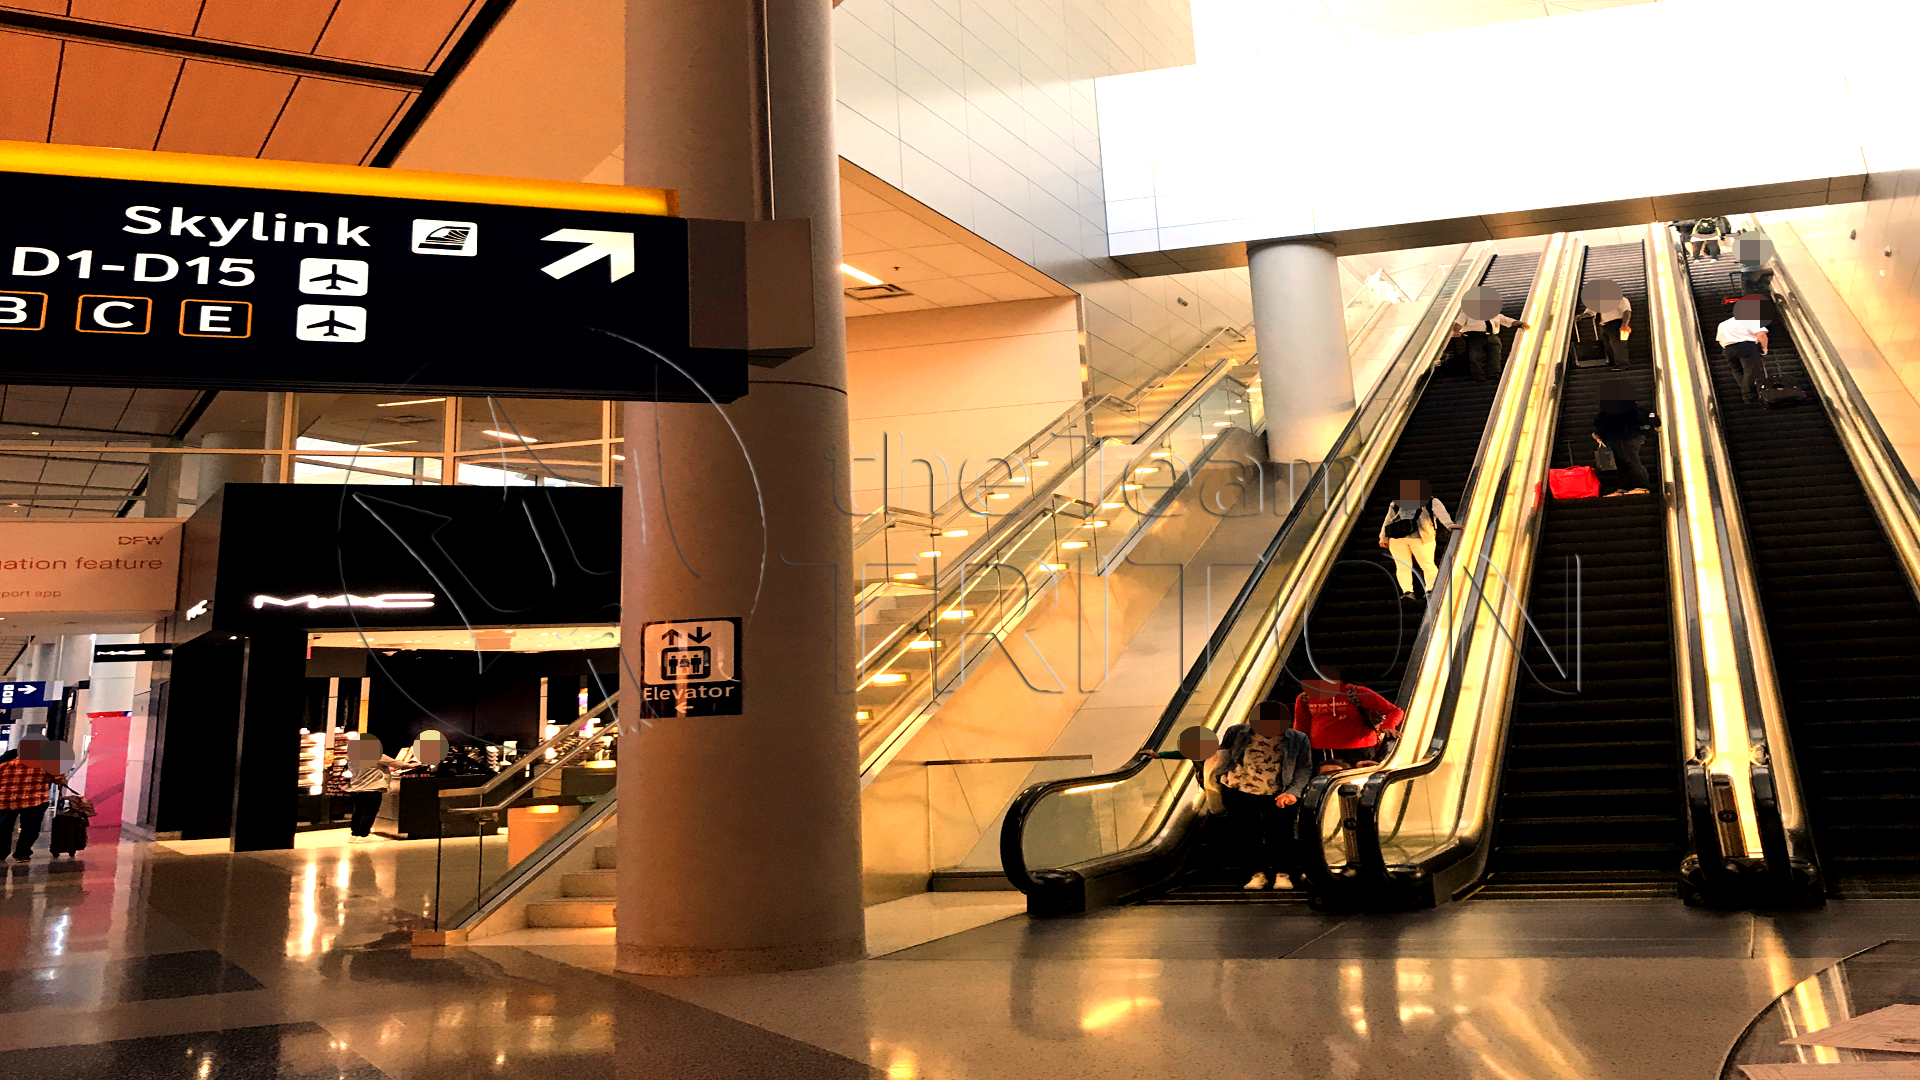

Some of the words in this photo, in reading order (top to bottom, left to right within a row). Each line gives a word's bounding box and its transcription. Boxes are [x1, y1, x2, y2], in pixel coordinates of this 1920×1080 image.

[122, 205, 371, 247] Skylink
[12, 246, 255, 287] D1-D15
[93, 301, 135, 328] C
[199, 305, 232, 332] E
[118, 536, 164, 545] DFW
[0, 557, 66, 570] ation
[75, 556, 163, 570] feature
[0, 590, 30, 598] port
[34, 590, 62, 598] app
[643, 685, 735, 701] Elevator
